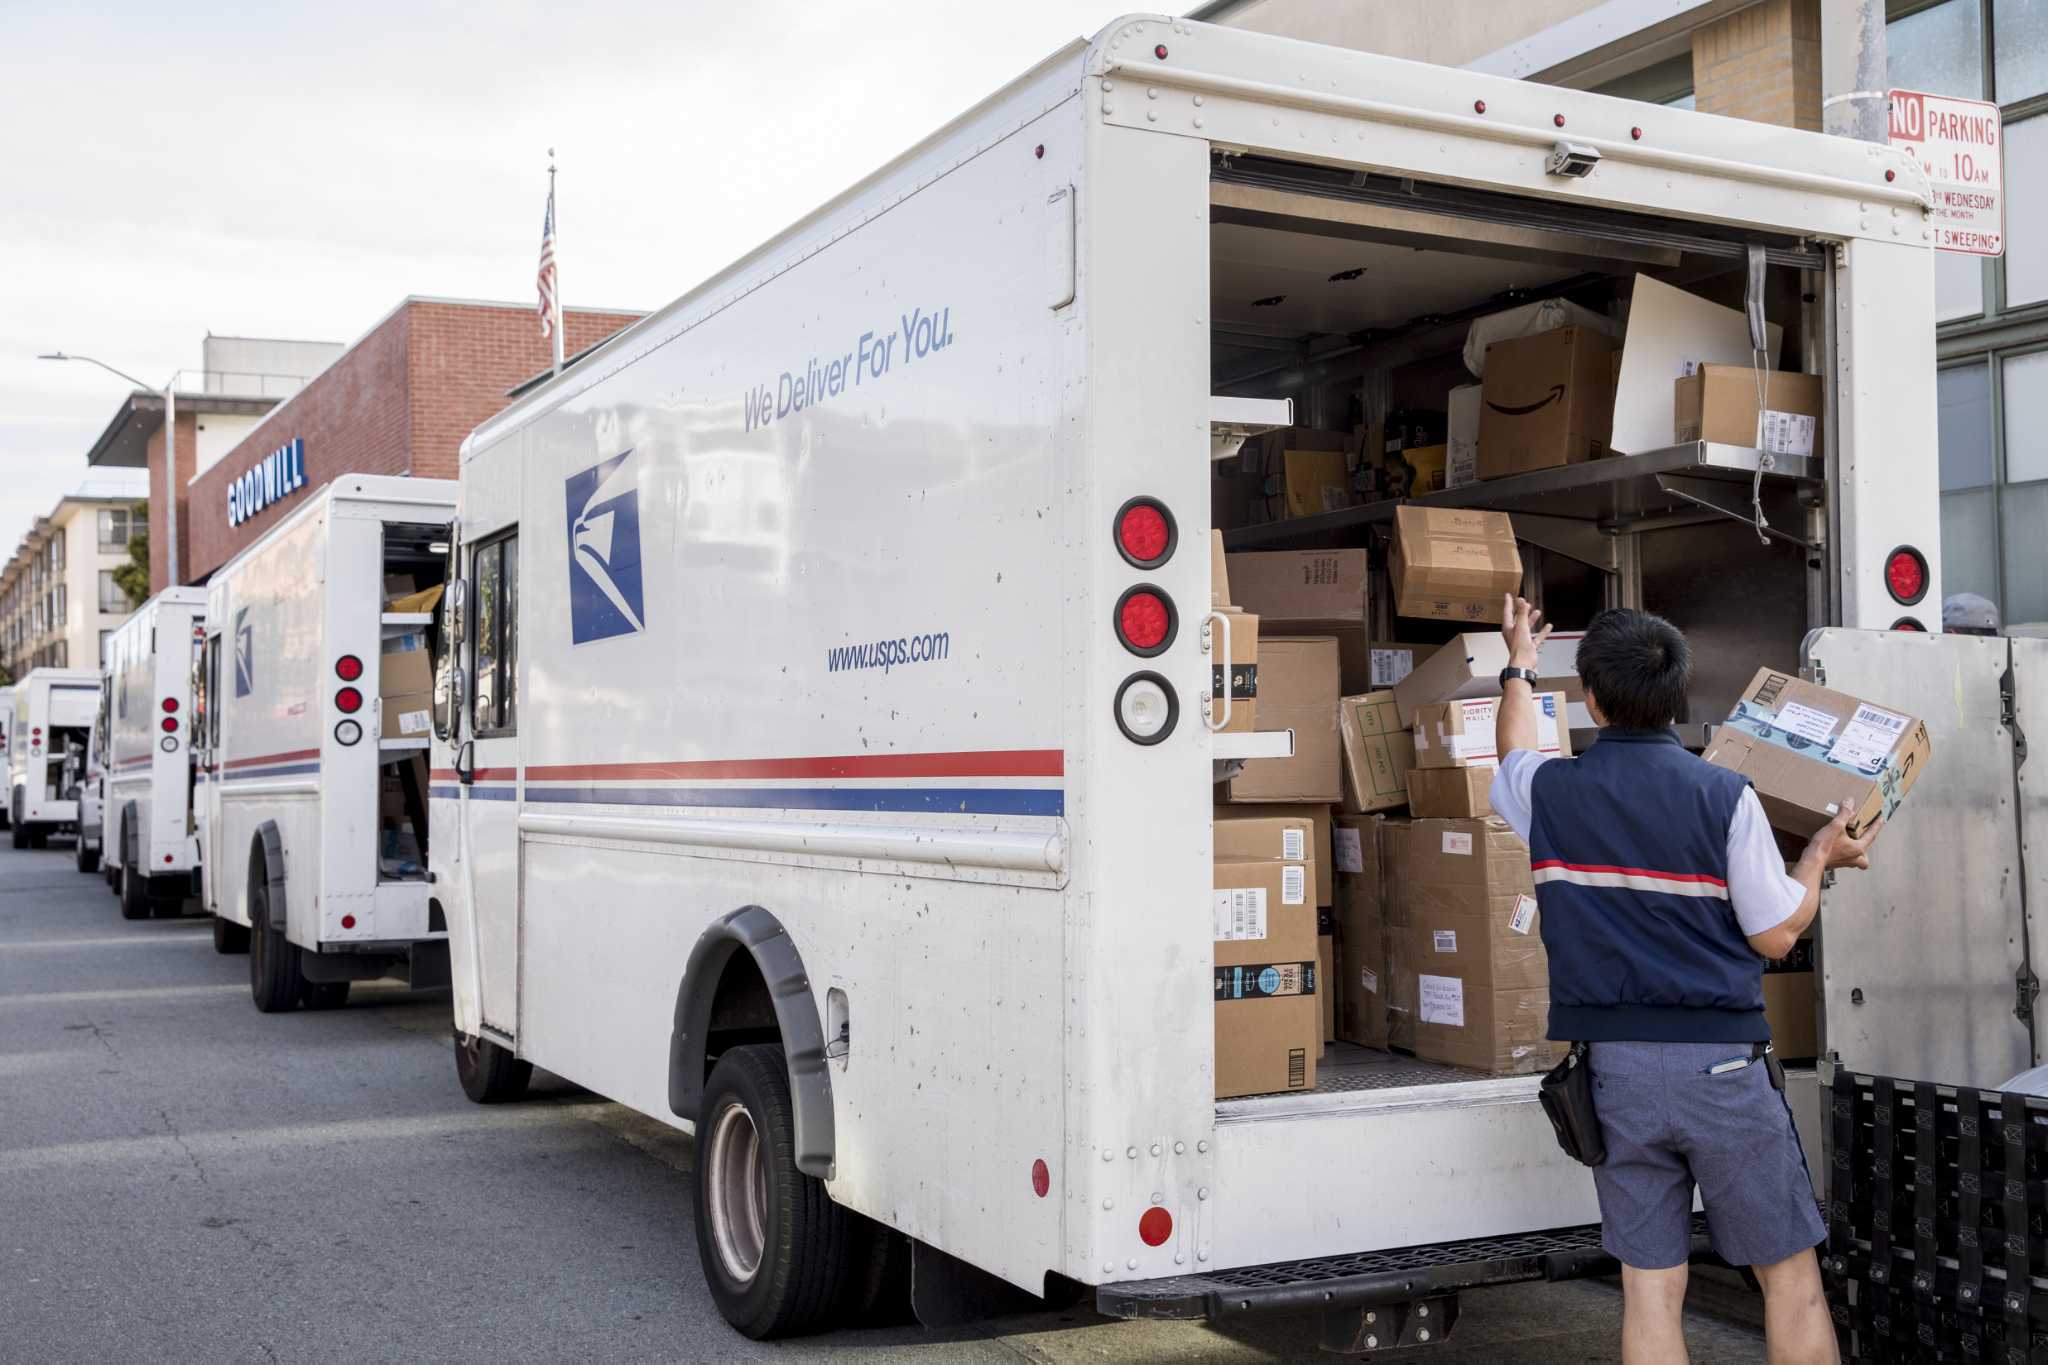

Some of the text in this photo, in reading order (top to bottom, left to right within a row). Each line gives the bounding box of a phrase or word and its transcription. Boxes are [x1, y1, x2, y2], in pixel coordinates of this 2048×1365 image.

[1892, 96, 1994, 146] NO PARKING
[1936, 207, 1974, 220] THE MONTH
[1944, 191, 1995, 210] WEDNESDAY
[1944, 229, 1994, 249] SWEEPING
[745, 307, 953, 433] We Deliver For You.
[227, 438, 305, 528] GOODWILL
[828, 632, 949, 675] www.usps.com
